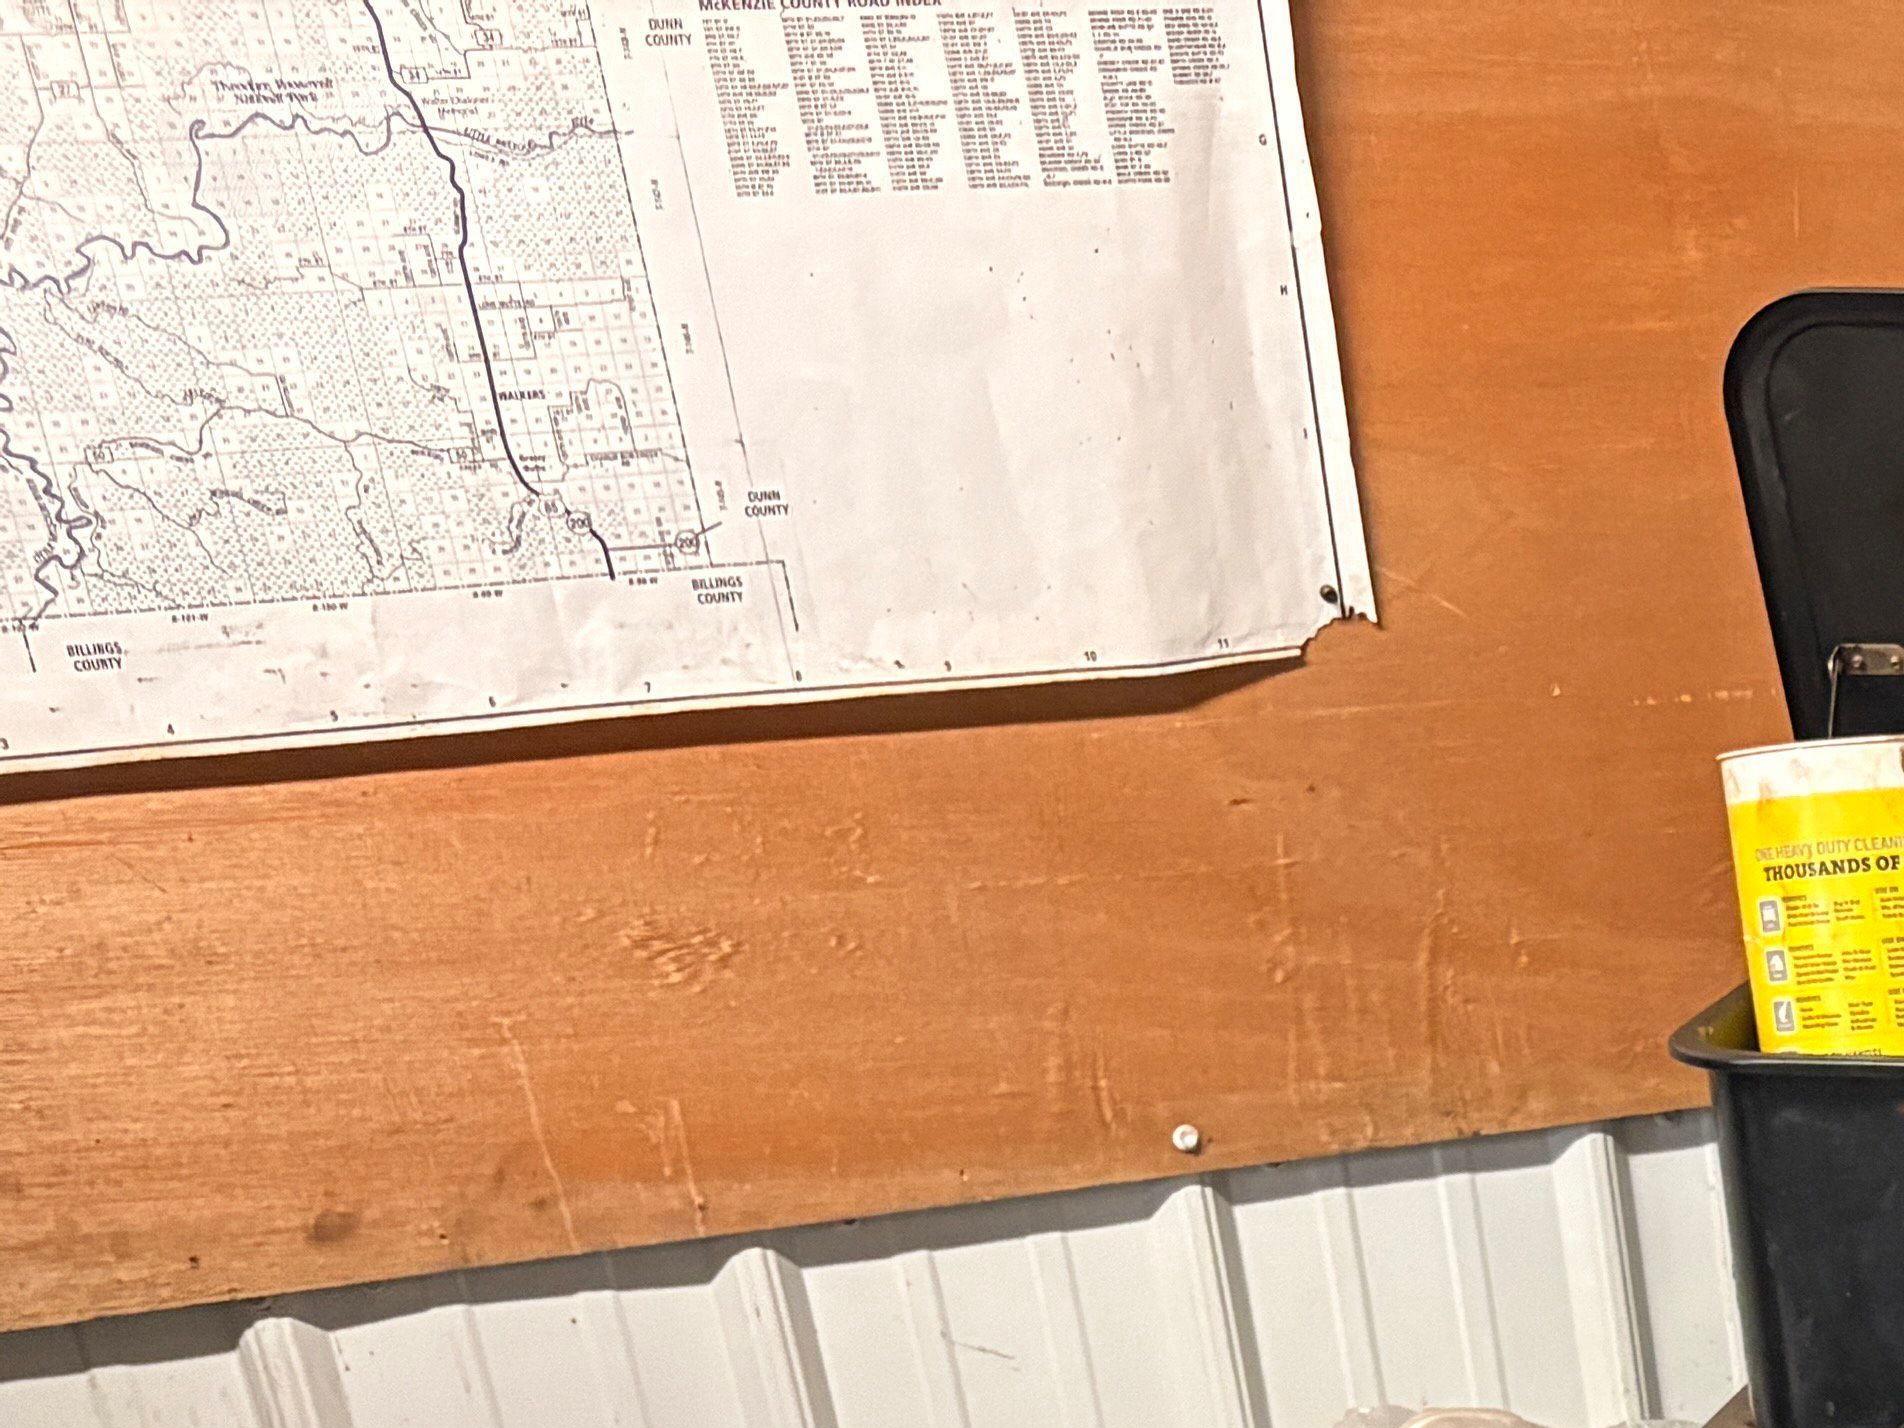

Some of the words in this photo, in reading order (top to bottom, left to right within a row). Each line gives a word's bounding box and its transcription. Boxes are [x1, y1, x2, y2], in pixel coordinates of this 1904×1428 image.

[649, 19, 683, 30] DUNN
[645, 34, 692, 46] COUNTY
[748, 491, 780, 502] DUNN
[745, 505, 788, 517] COUNTY
[692, 576, 742, 590] BILLINGS
[698, 592, 743, 604] COUNTY
[67, 642, 122, 657] BILLINGS
[74, 658, 122, 672] COUNTY
[1816, 838, 1852, 855] DUTY
[1763, 857, 1871, 882] THOUSANDS
[1876, 855, 1901, 871] OF
